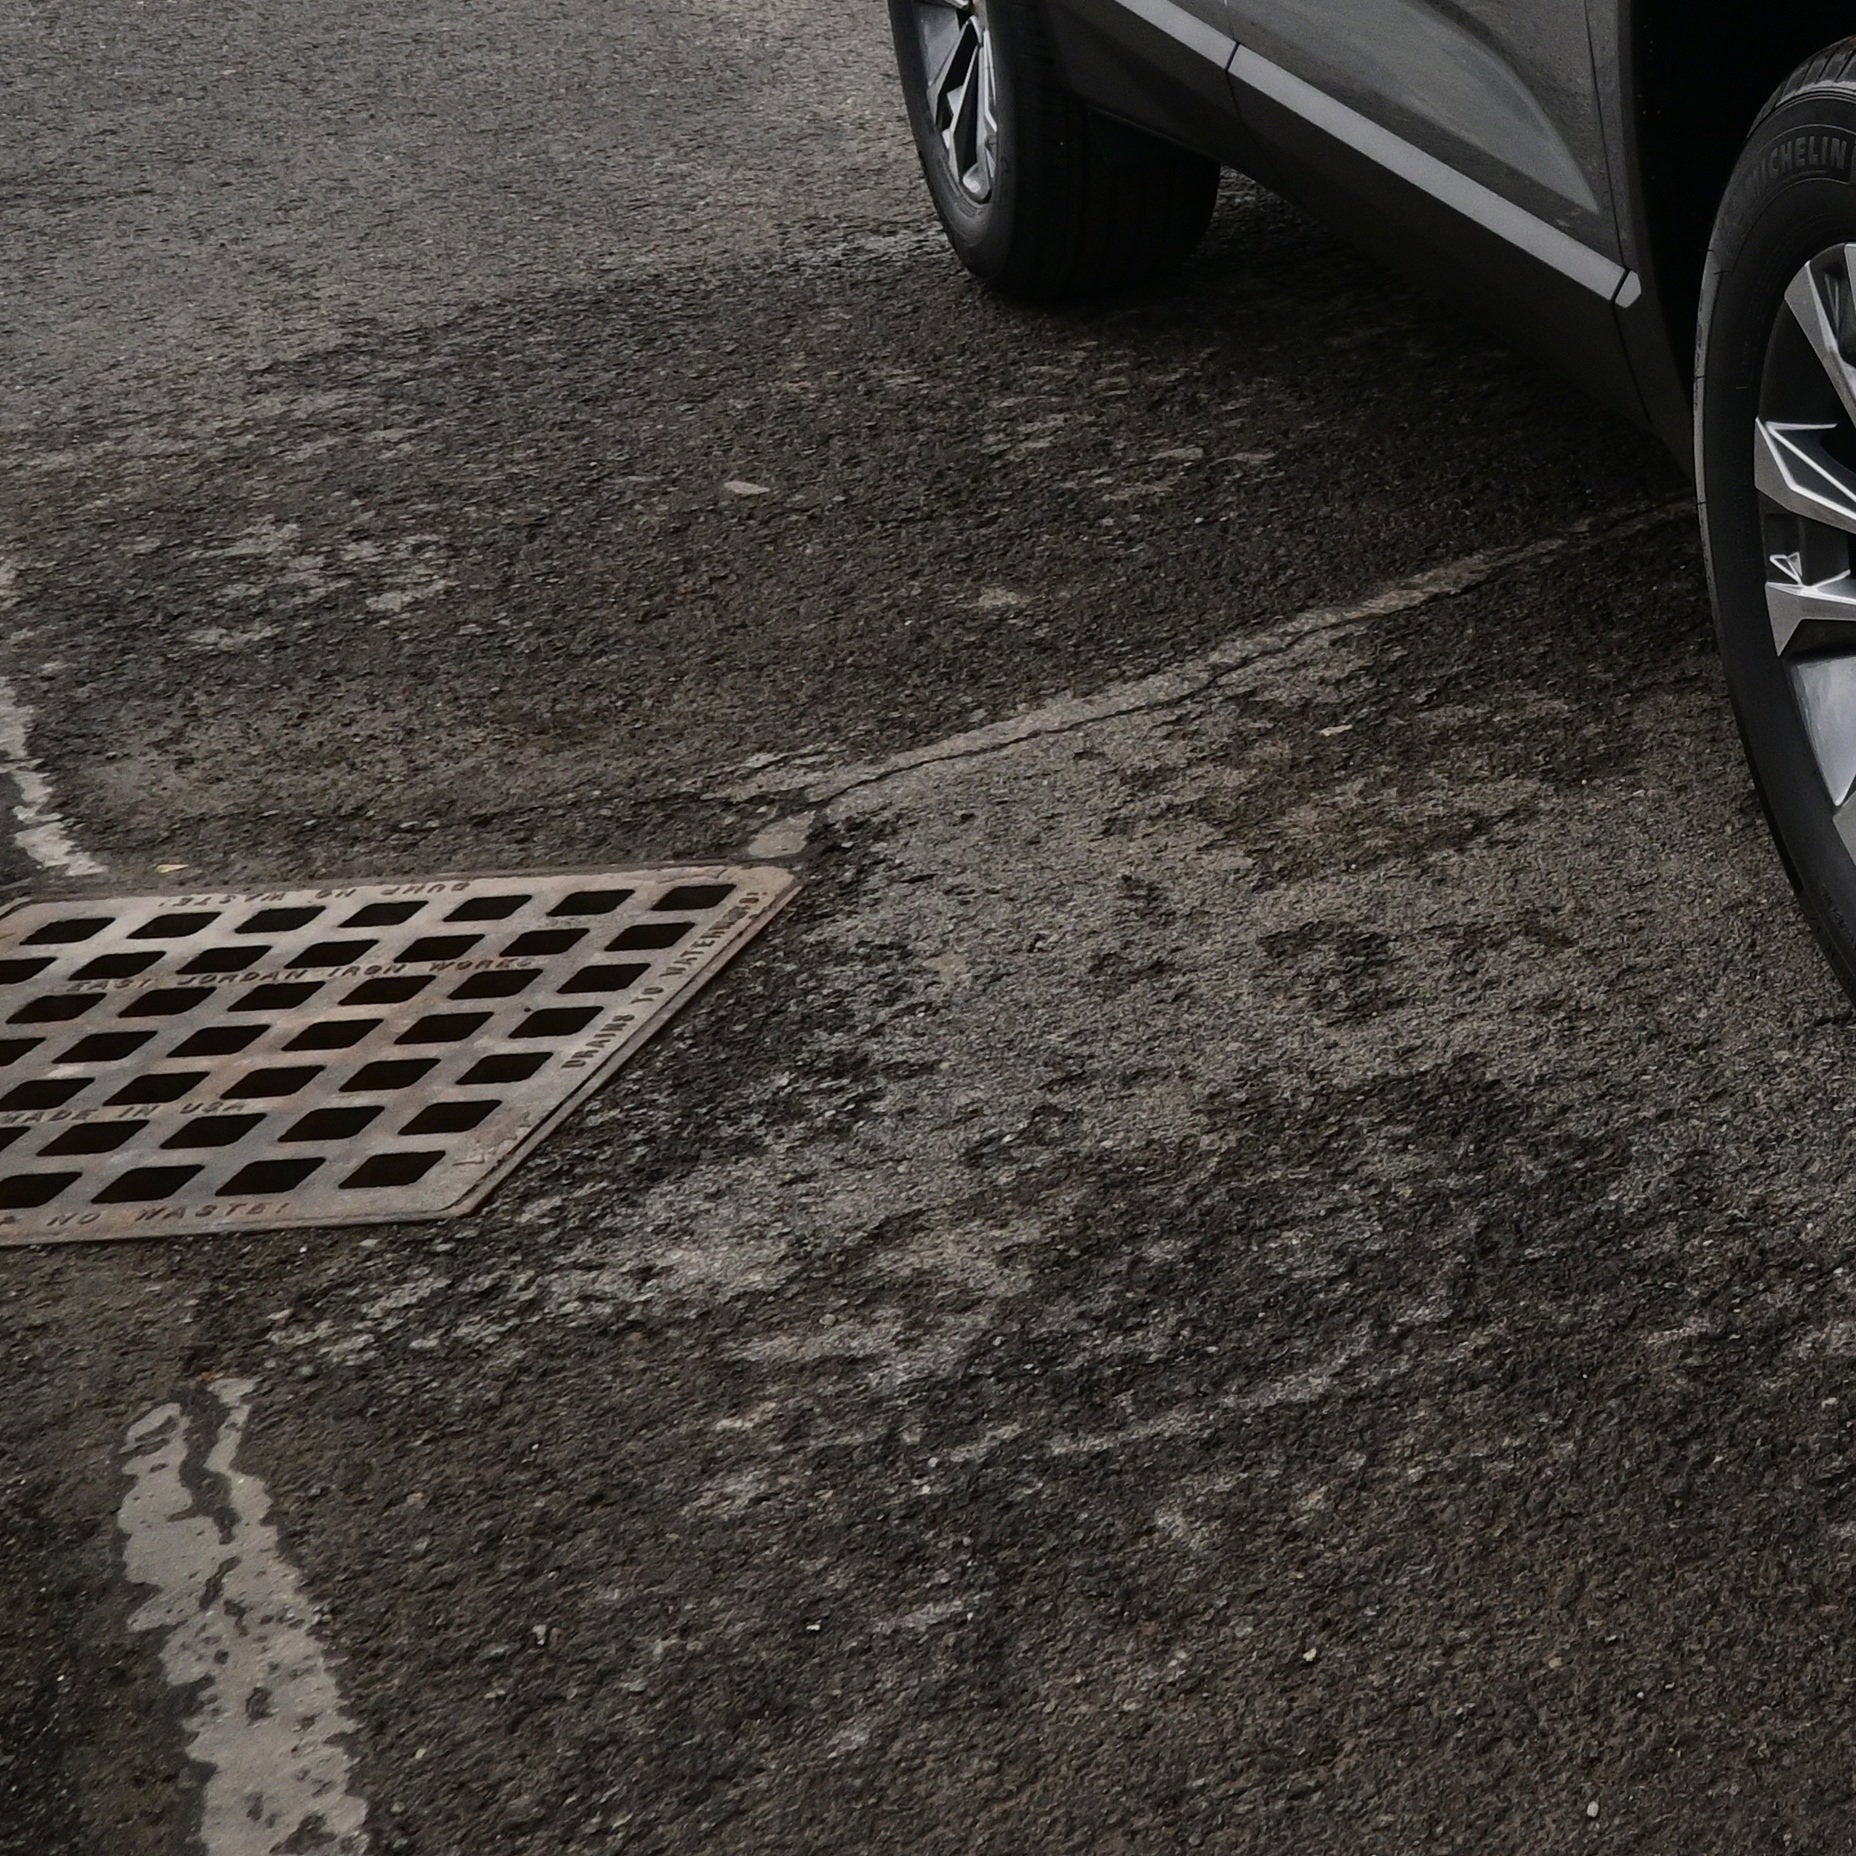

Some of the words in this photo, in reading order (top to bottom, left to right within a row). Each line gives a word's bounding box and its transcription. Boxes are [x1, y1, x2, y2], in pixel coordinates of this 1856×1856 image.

[381, 883, 470, 896] DUMP
[178, 969, 303, 985] JORDAN
[328, 963, 407, 977] IRON
[46, 1212, 102, 1226] NO
